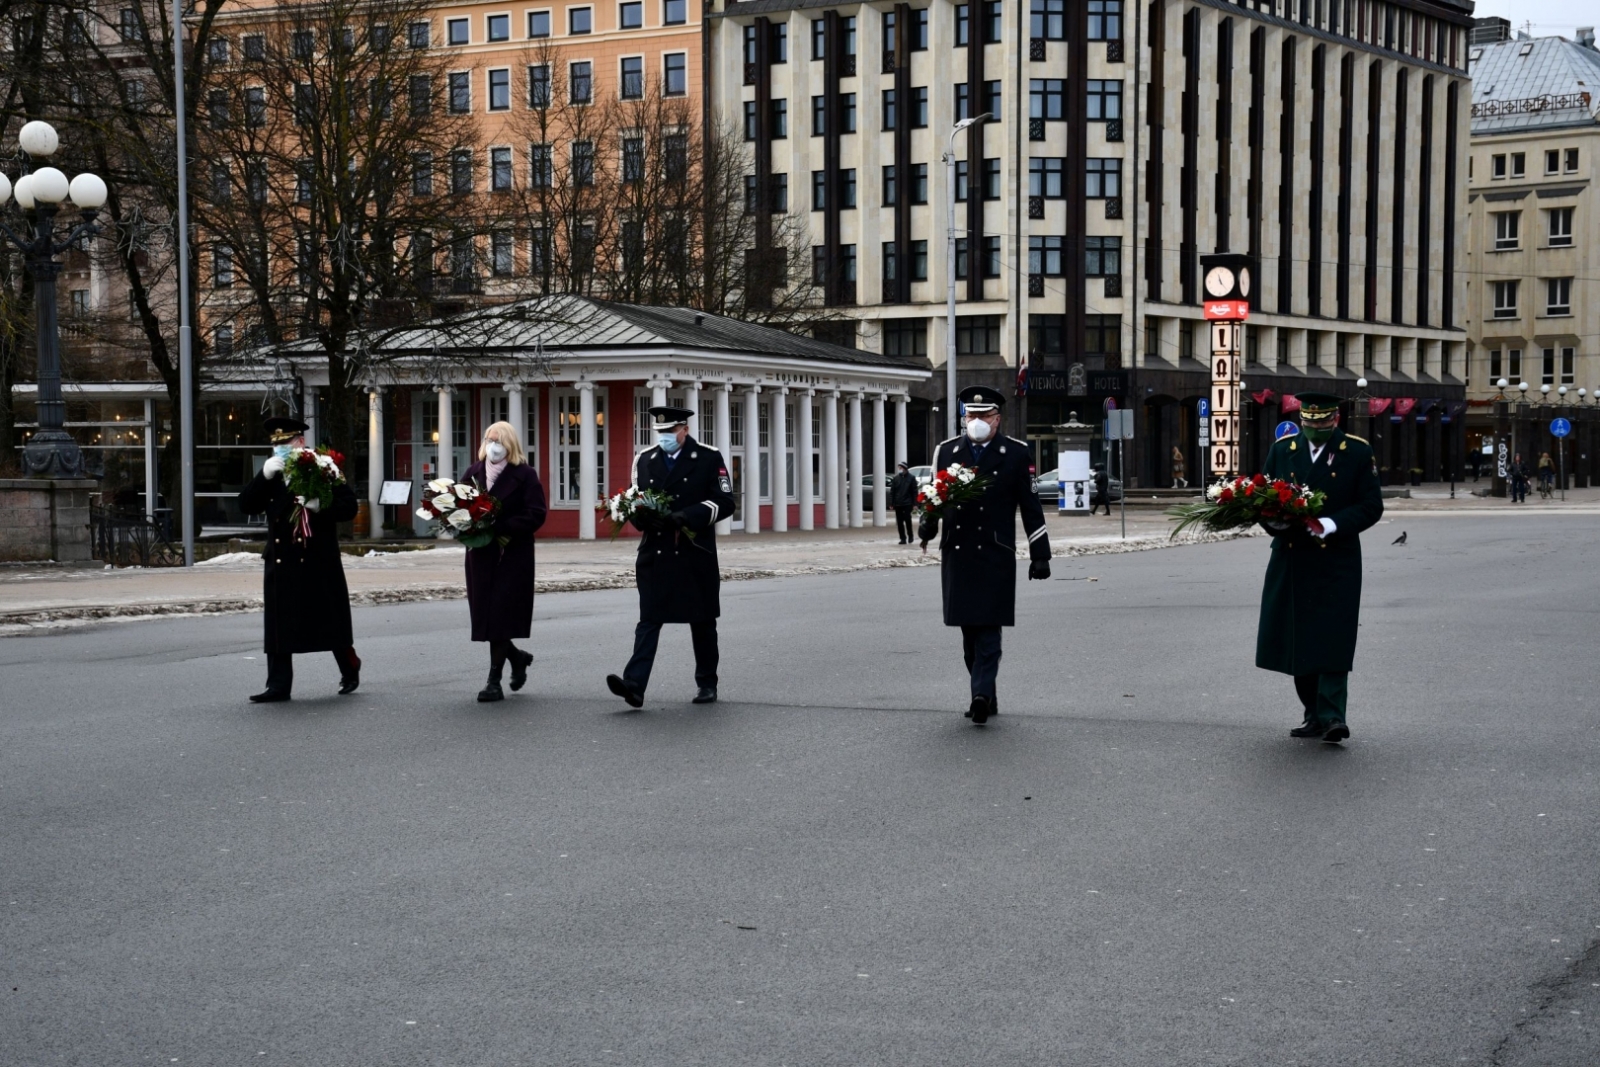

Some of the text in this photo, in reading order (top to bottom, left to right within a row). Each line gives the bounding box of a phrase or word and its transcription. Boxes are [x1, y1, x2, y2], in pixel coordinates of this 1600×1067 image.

[676, 367, 724, 378] WINE RESTAURANT
[1029, 374, 1066, 390] VIESNĪCA
[1094, 376, 1121, 390] HOTEL
[1215, 328, 1228, 468] LAIMA
[1201, 400, 1207, 415] P
